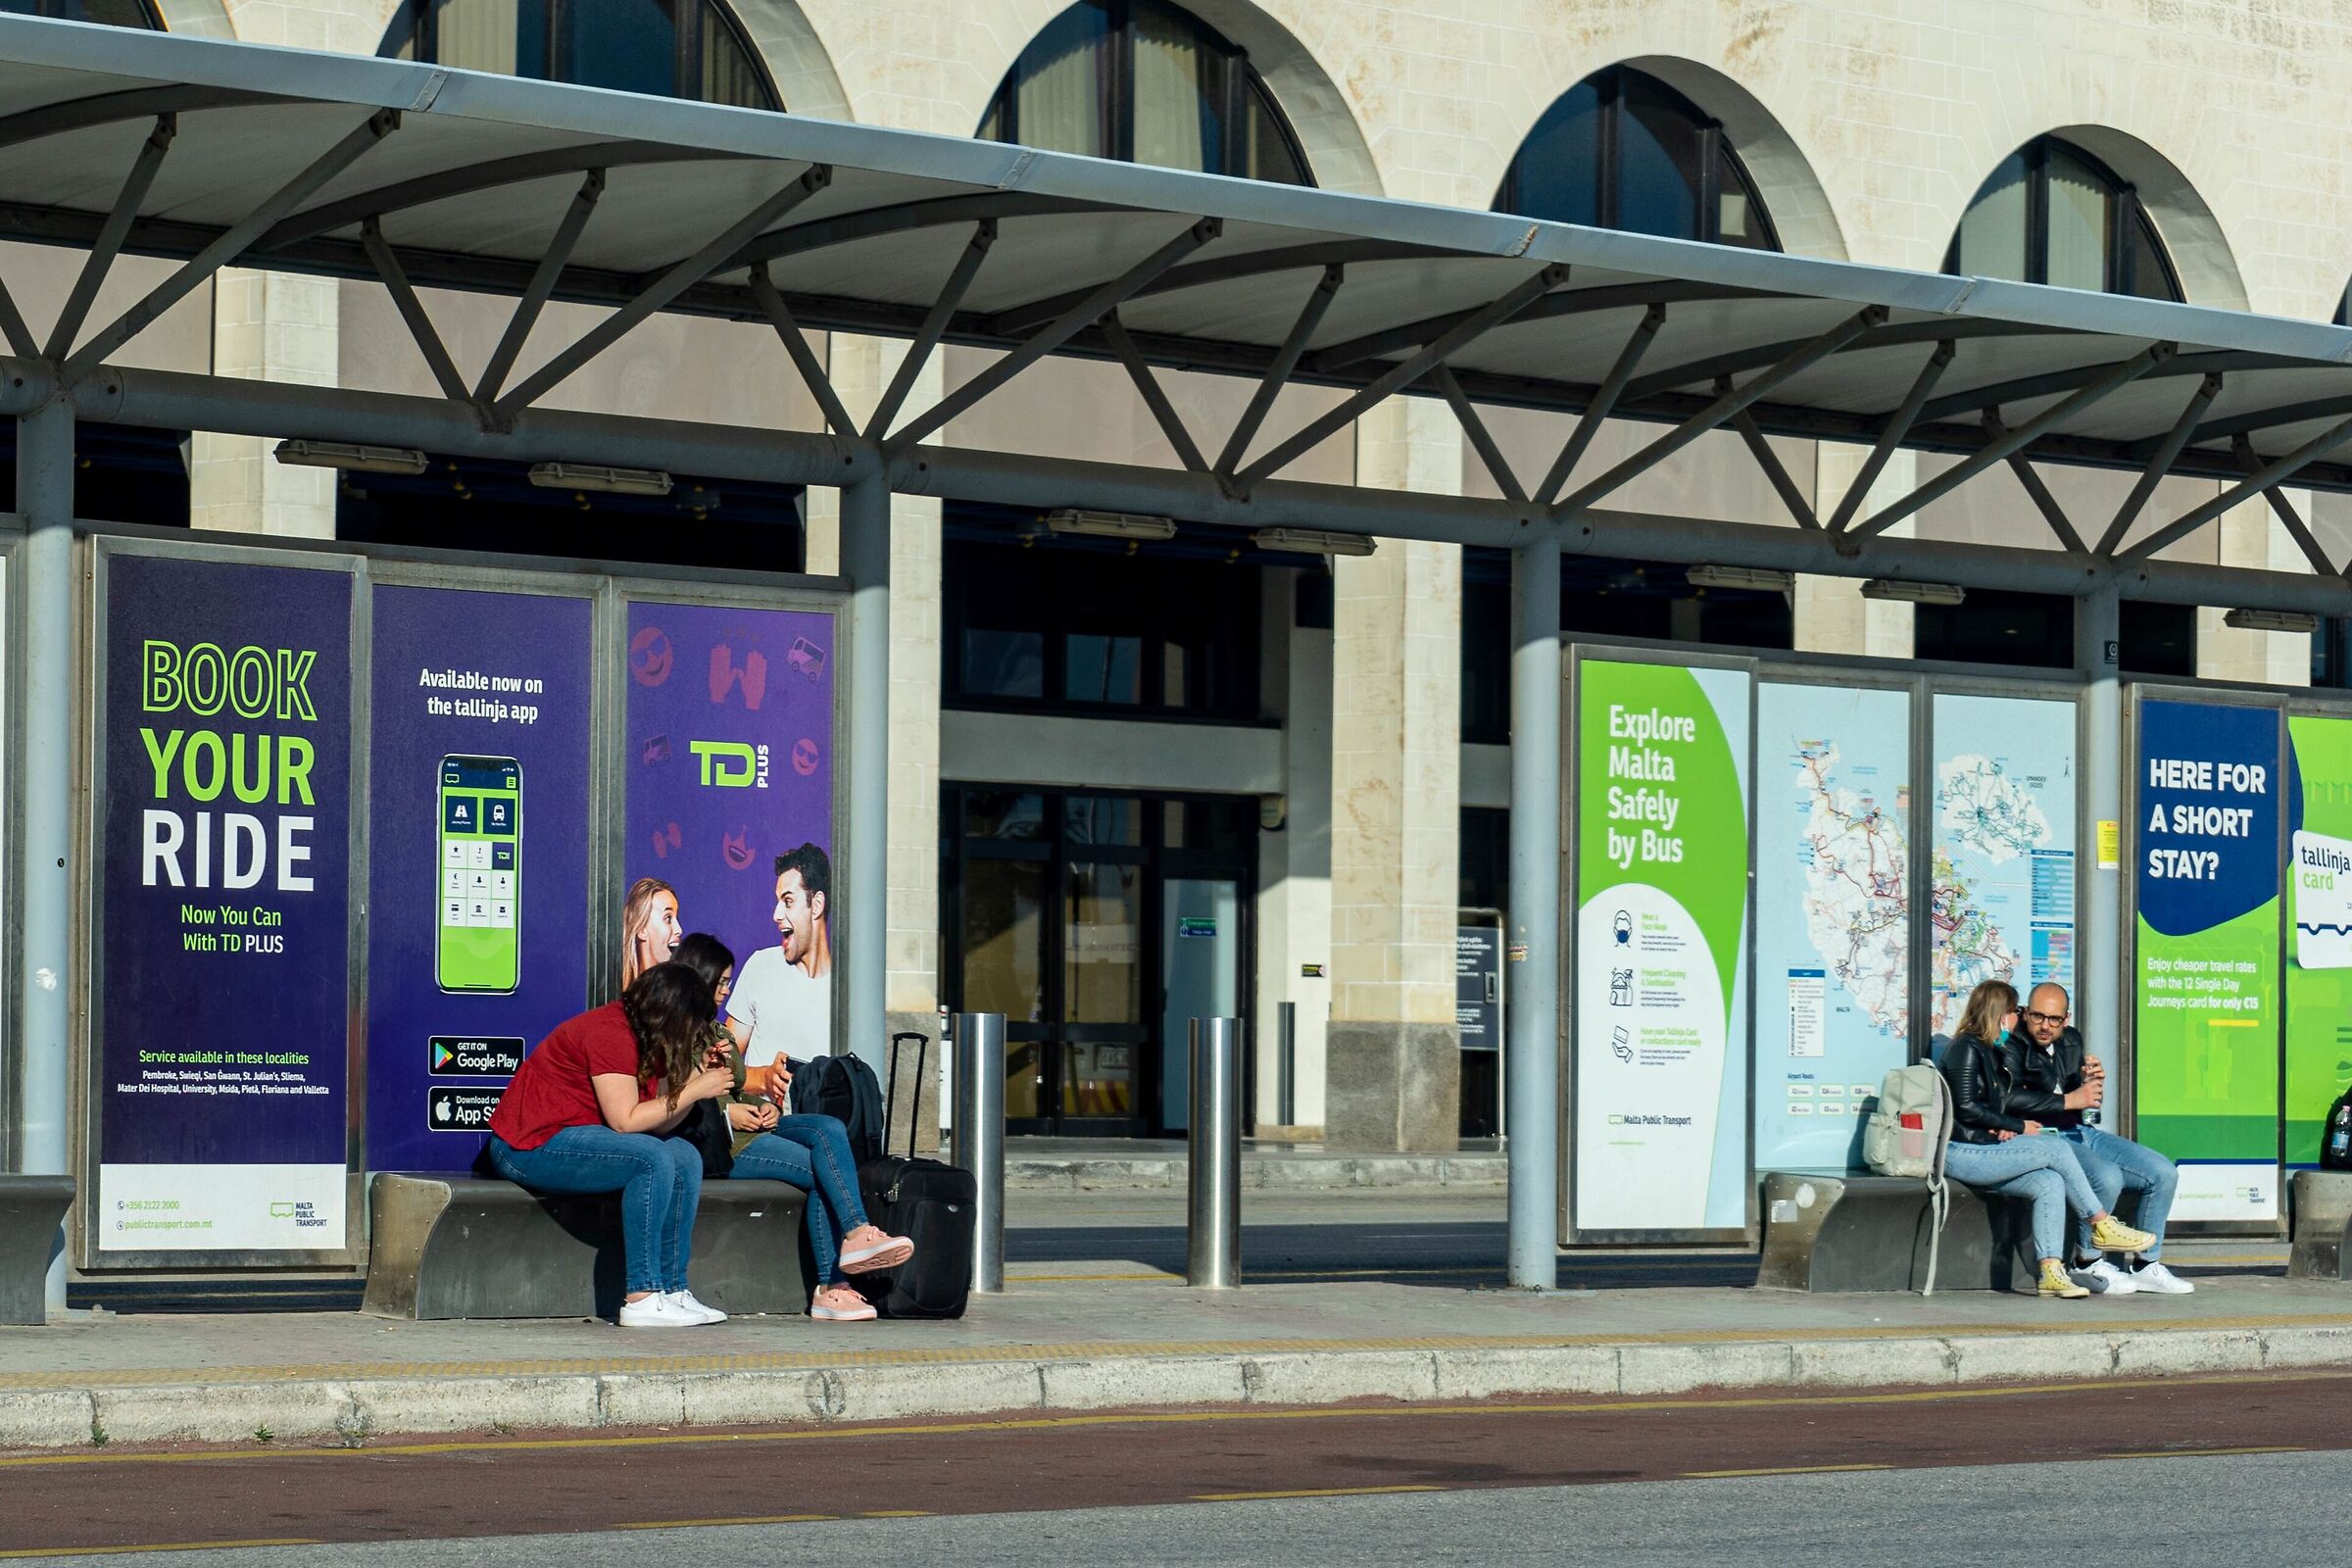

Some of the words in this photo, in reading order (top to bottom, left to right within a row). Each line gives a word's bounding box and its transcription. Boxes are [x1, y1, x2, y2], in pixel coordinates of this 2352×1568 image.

[143, 639, 318, 721] BOOK
[419, 668, 489, 690] Available
[492, 676, 522, 692] now
[524, 678, 543, 694] on
[427, 696, 452, 715] the
[455, 698, 509, 723] tallinja
[511, 705, 538, 725] app
[1609, 705, 1695, 748] Explore
[139, 728, 316, 806] YOUR
[690, 740, 756, 788] TD
[757, 744, 769, 789] PLUS
[1608, 746, 1676, 782] Malta
[2150, 759, 2213, 791] HERE
[2218, 762, 2266, 794] FOR
[1607, 786, 1679, 831] Safely
[2148, 804, 2169, 833] A
[2173, 805, 2253, 837] SHORT
[142, 808, 315, 892] RIDE
[1608, 827, 1637, 870] by
[1642, 828, 1683, 863] Bus
[2148, 848, 2220, 880] STAY?
[2301, 846, 2351, 875] tallinja
[2303, 871, 2333, 891] card
[181, 904, 217, 924] Now
[220, 906, 248, 925] You
[253, 906, 281, 926] Can
[183, 933, 217, 952] With
[220, 934, 241, 952] TD
[245, 934, 284, 954] PLUS
[2147, 957, 2172, 972] Enjoy
[2173, 958, 2208, 972] cheaper
[2210, 959, 2234, 972] travel
[2235, 961, 2257, 973] rates
[2147, 976, 2166, 989] with
[2168, 976, 2182, 989] the
[2183, 976, 2194, 989] 12
[2194, 976, 2223, 992] Single
[2223, 978, 2240, 993] Day
[2147, 995, 2186, 1010] Journeys
[2187, 996, 2208, 1008] card
[2208, 996, 2222, 1008] for
[2223, 997, 2242, 1011] only
[139, 1050, 176, 1063] Service
[178, 1051, 223, 1064] available
[224, 1051, 235, 1064] in
[236, 1052, 264, 1064] these
[266, 1052, 310, 1065] localities
[457, 1053, 496, 1071] Google
[497, 1054, 519, 1072] Play
[142, 1070, 178, 1081] Pembroke,
[179, 1070, 203, 1082] Swieqi,
[203, 1071, 217, 1080] San
[242, 1071, 253, 1081] St.
[280, 1071, 306, 1082] Sliema,
[118, 1083, 138, 1093] Mater
[138, 1083, 151, 1093] Dei
[151, 1084, 181, 1095] Hospital,
[182, 1084, 218, 1096] University,
[219, 1085, 241, 1095] Msida,
[261, 1085, 289, 1095] Floriana
[289, 1085, 303, 1095] and
[303, 1086, 330, 1095] Valletta
[456, 1096, 490, 1104] Download
[455, 1105, 481, 1125] App
[1624, 1114, 1642, 1125] Malta
[1642, 1114, 1662, 1125] Public
[1662, 1114, 1691, 1127] Transport
[143, 1200, 161, 1210] 2122
[295, 1201, 314, 1210] MALTA
[124, 1219, 213, 1231] publictransport.com.mt
